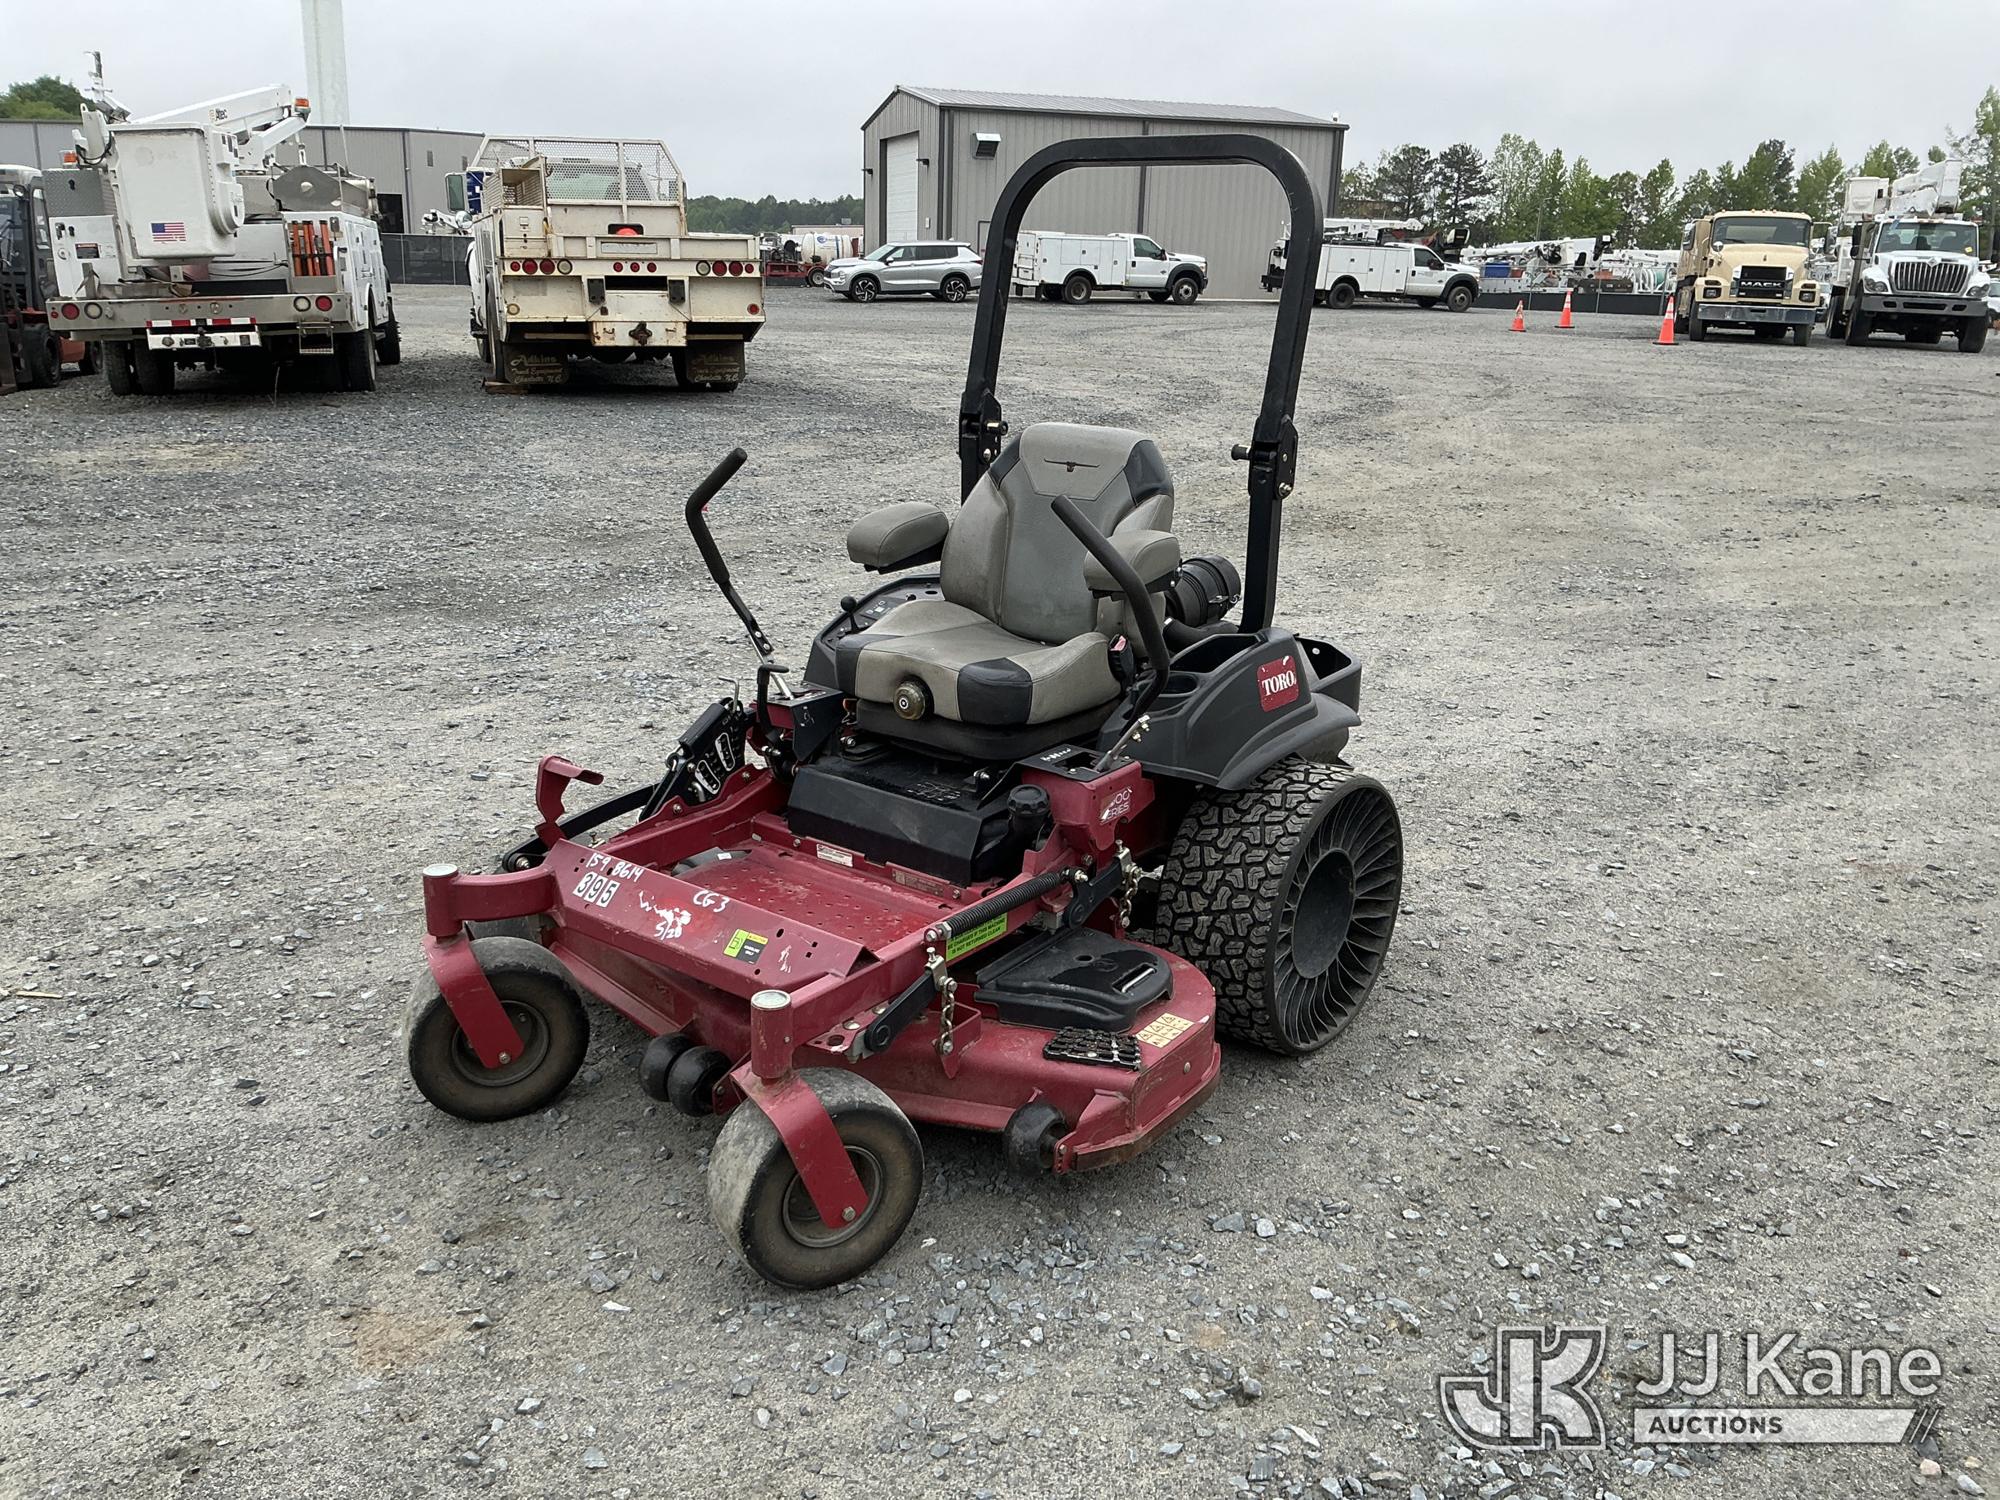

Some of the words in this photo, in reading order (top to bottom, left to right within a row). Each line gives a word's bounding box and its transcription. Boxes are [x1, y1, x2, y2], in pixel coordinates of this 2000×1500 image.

[1261, 670, 1295, 697] TORO
[585, 852, 612, 872] 159
[611, 861, 646, 883] 8614
[574, 872, 619, 906] 395
